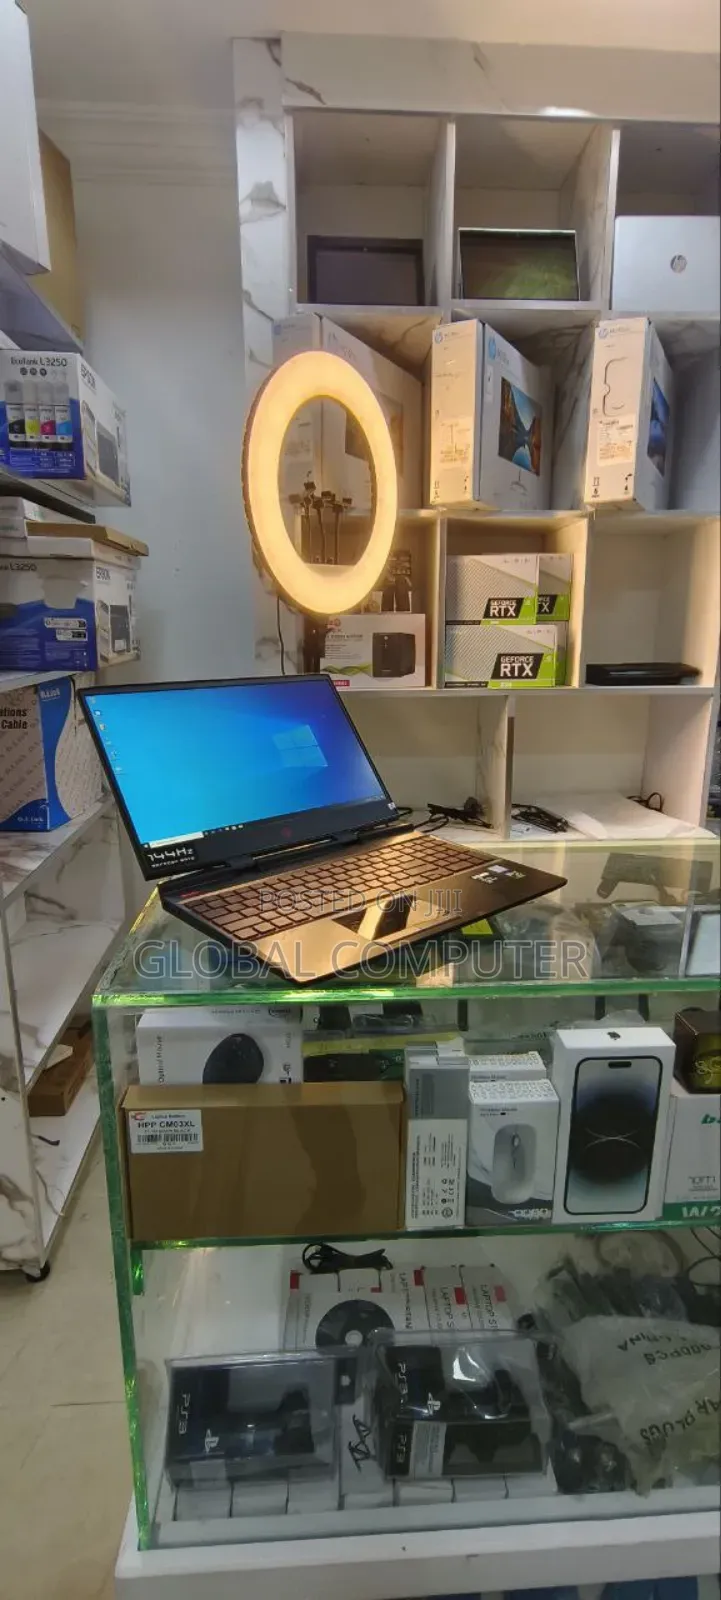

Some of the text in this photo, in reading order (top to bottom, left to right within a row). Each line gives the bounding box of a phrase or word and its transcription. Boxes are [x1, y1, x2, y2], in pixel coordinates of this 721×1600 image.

[39, 358, 67, 366] L3250
[490, 606, 516, 617] RTX
[500, 663, 533, 677] RTX
[1, 719, 28, 729] Cable
[179, 1393, 191, 1434] PS3
